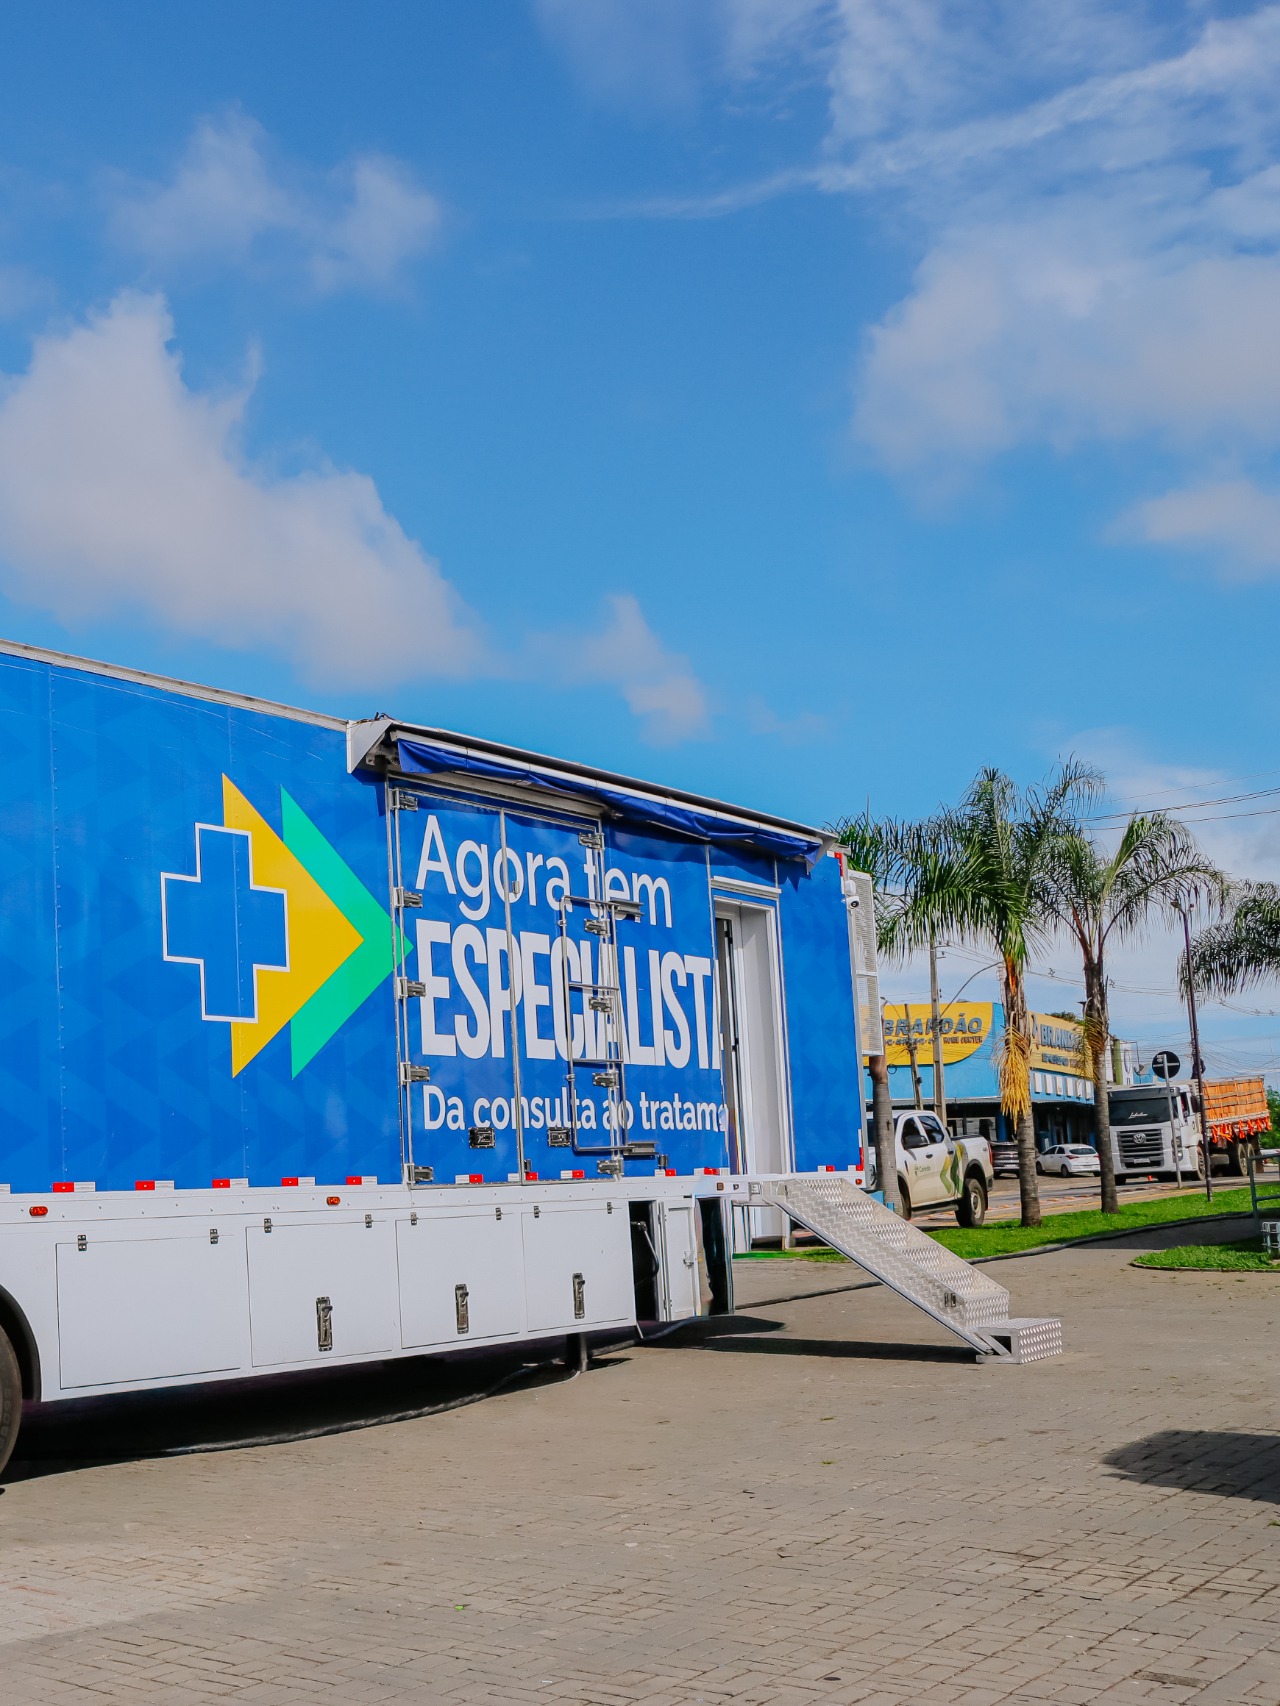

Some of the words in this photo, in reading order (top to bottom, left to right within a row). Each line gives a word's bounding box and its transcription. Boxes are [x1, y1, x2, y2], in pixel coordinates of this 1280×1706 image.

[415, 814, 573, 921] Agora
[583, 847, 673, 928] tem
[422, 1085, 466, 1130] Da
[473, 1086, 597, 1131] consulta
[602, 1098, 634, 1130] ao
